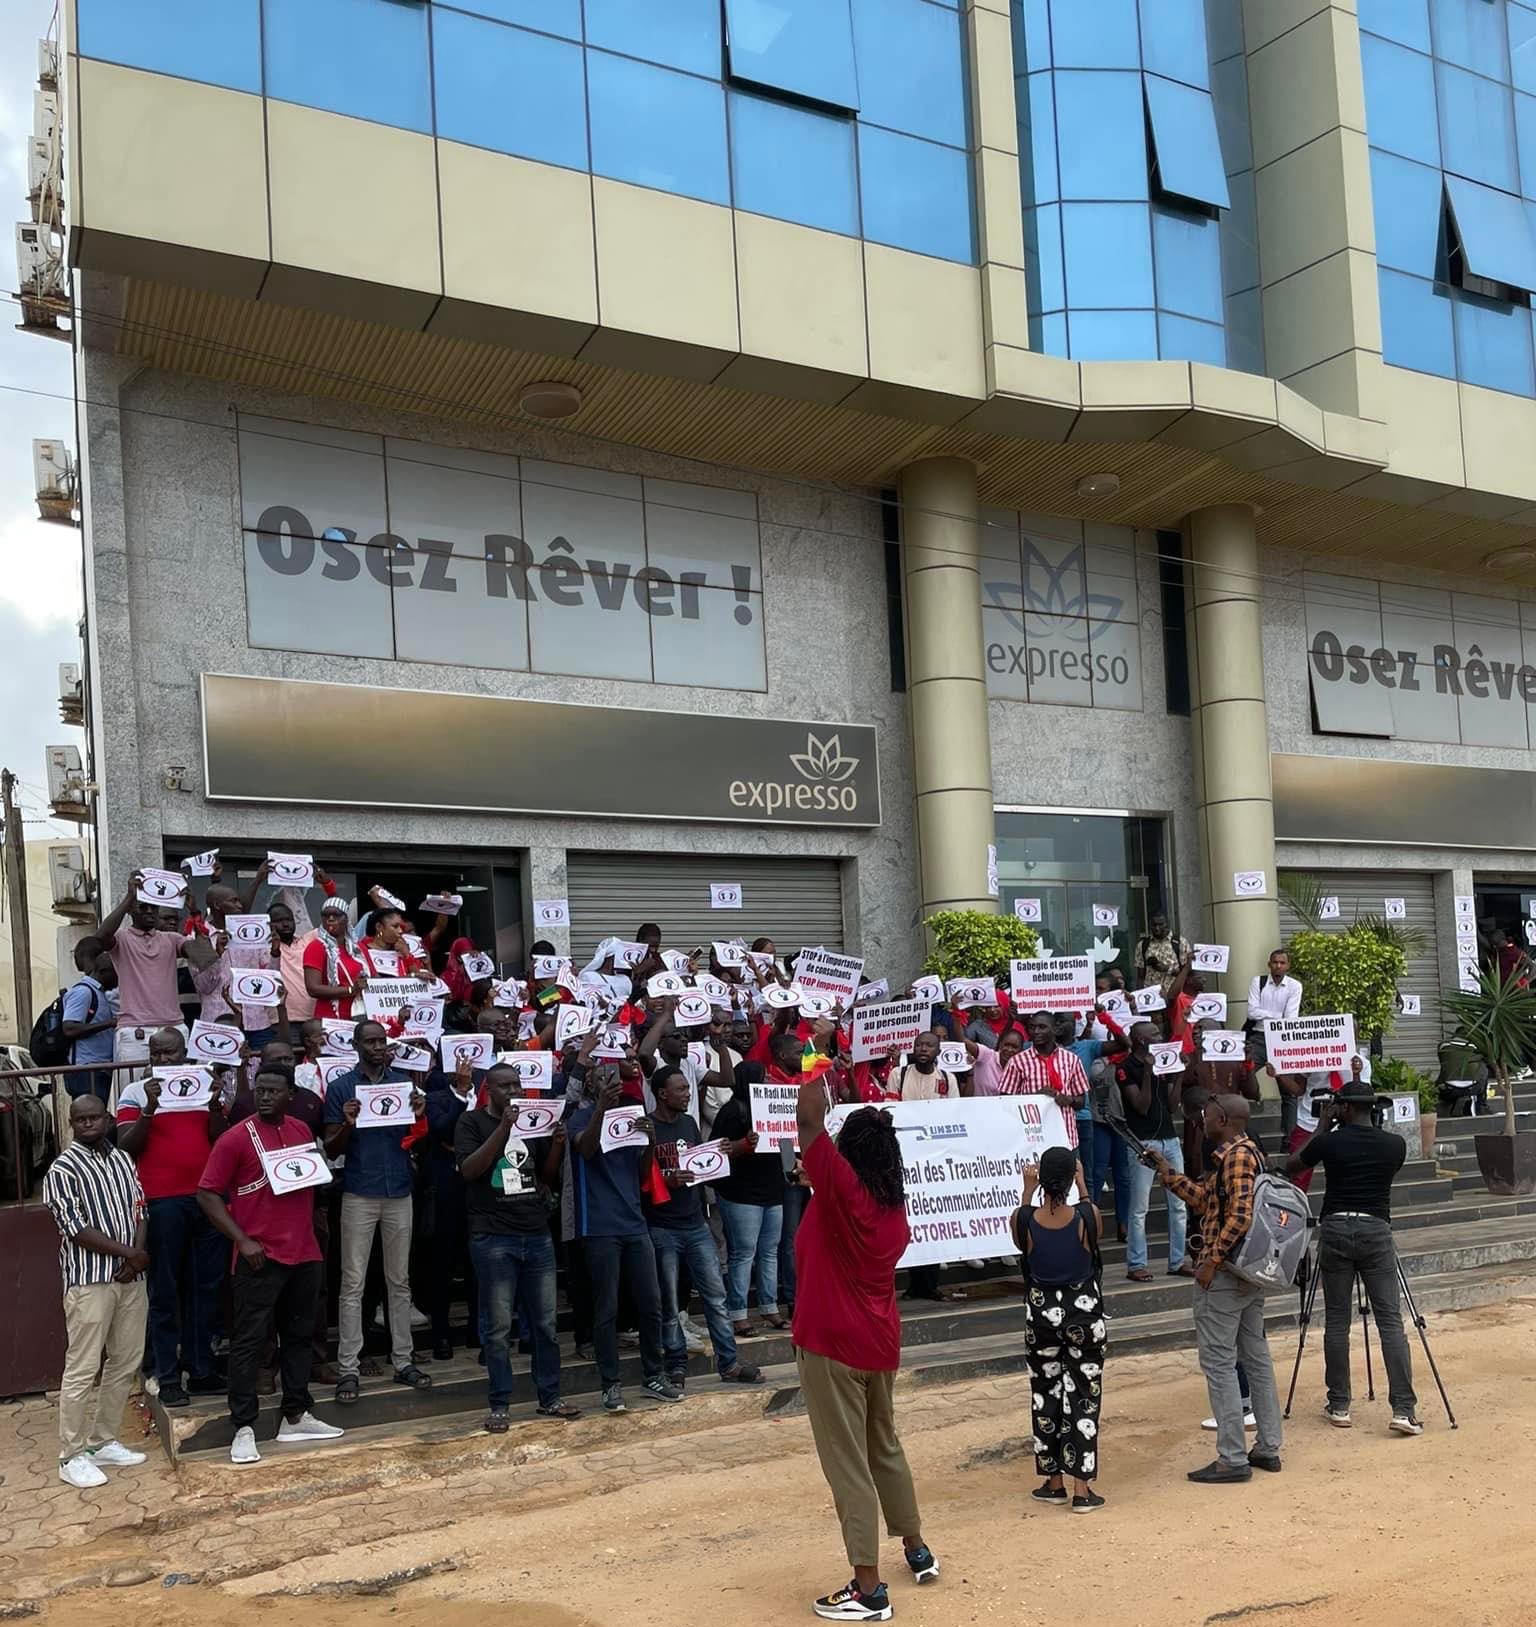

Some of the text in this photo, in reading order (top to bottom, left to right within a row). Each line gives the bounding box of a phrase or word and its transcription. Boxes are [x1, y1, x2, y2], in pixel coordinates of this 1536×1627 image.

[256, 505, 752, 626] Osez Rêver !
[987, 643, 1129, 685] expresso
[1312, 630, 1420, 691] Osez
[729, 780, 857, 815] expresso
[802, 949, 818, 961] STOP
[806, 963, 852, 980] de consultants
[1016, 959, 1089, 971] Gabegie et gestion
[798, 975, 817, 987] STOP
[401, 982, 429, 995] gestion
[1016, 985, 1090, 998] Mismanagement and
[869, 1008, 880, 1018] ne
[882, 1003, 912, 1016] touche
[913, 1002, 930, 1012] pas
[1048, 998, 1095, 1009] management
[864, 1013, 921, 1031] au personnel
[1270, 1021, 1283, 1032] DG
[862, 1028, 920, 1045] We don't touch
[1281, 1028, 1340, 1041] et incapable
[1330, 1043, 1347, 1053] and
[1326, 1057, 1342, 1066] CEO
[753, 1087, 763, 1099] Mr.
[764, 1087, 780, 1099] Radi
[1018, 1103, 1041, 1125] UNI
[767, 1120, 781, 1132] Radi
[903, 1161, 922, 1185] nal
[924, 1159, 946, 1183] des
[946, 1155, 1012, 1181] Travailleurs
[904, 1184, 1020, 1217] Télécommunications
[911, 1221, 967, 1244] CTORIEL
